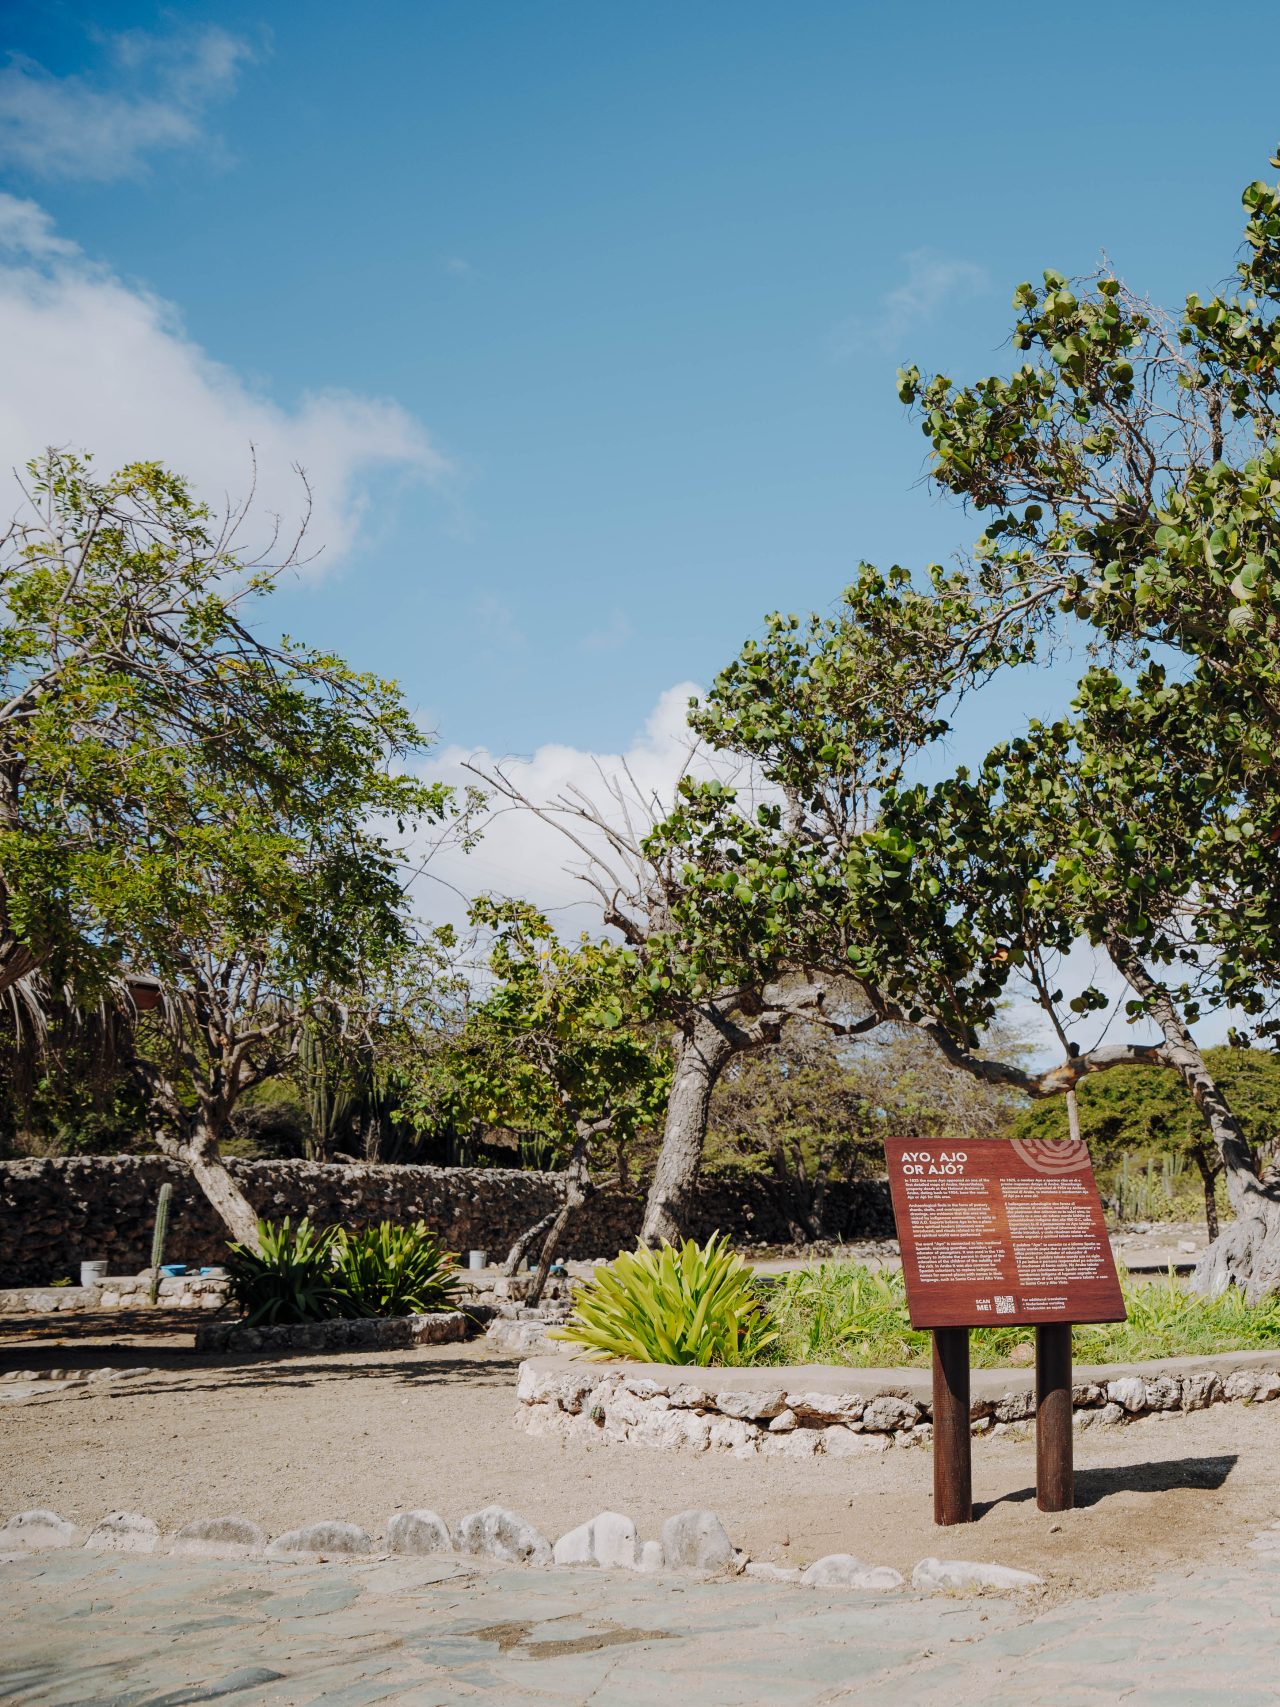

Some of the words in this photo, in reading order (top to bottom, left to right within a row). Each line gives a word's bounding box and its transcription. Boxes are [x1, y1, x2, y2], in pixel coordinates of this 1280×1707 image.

[901, 1152, 935, 1163] AYO,
[940, 1152, 968, 1162] AJO
[902, 1164, 924, 1175] OR
[928, 1162, 964, 1175] AJÓ?
